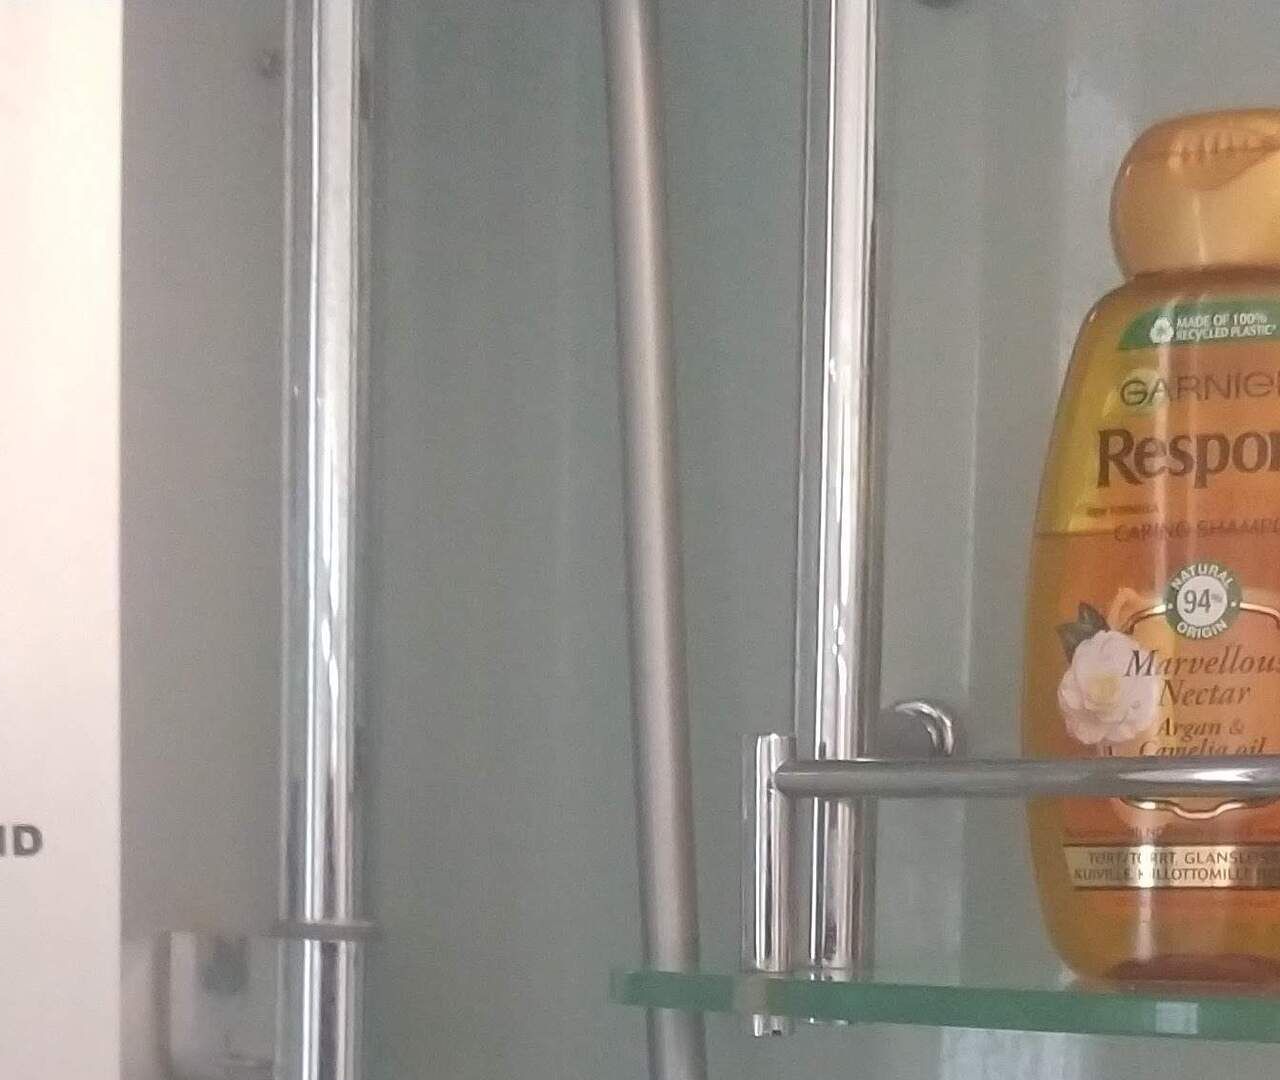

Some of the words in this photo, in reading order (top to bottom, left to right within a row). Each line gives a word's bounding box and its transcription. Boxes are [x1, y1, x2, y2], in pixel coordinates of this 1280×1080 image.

[1177, 314, 1210, 328] MADE
[1213, 313, 1229, 326] OF
[1233, 312, 1268, 326] 100%
[1176, 327, 1229, 341] RECYCLED
[1171, 563, 1234, 590] NATURAL
[1177, 618, 1228, 639] ORIGIN
[1158, 678, 1251, 707] Nectar
[1157, 717, 1223, 742] Argan
[1229, 717, 1245, 735] &
